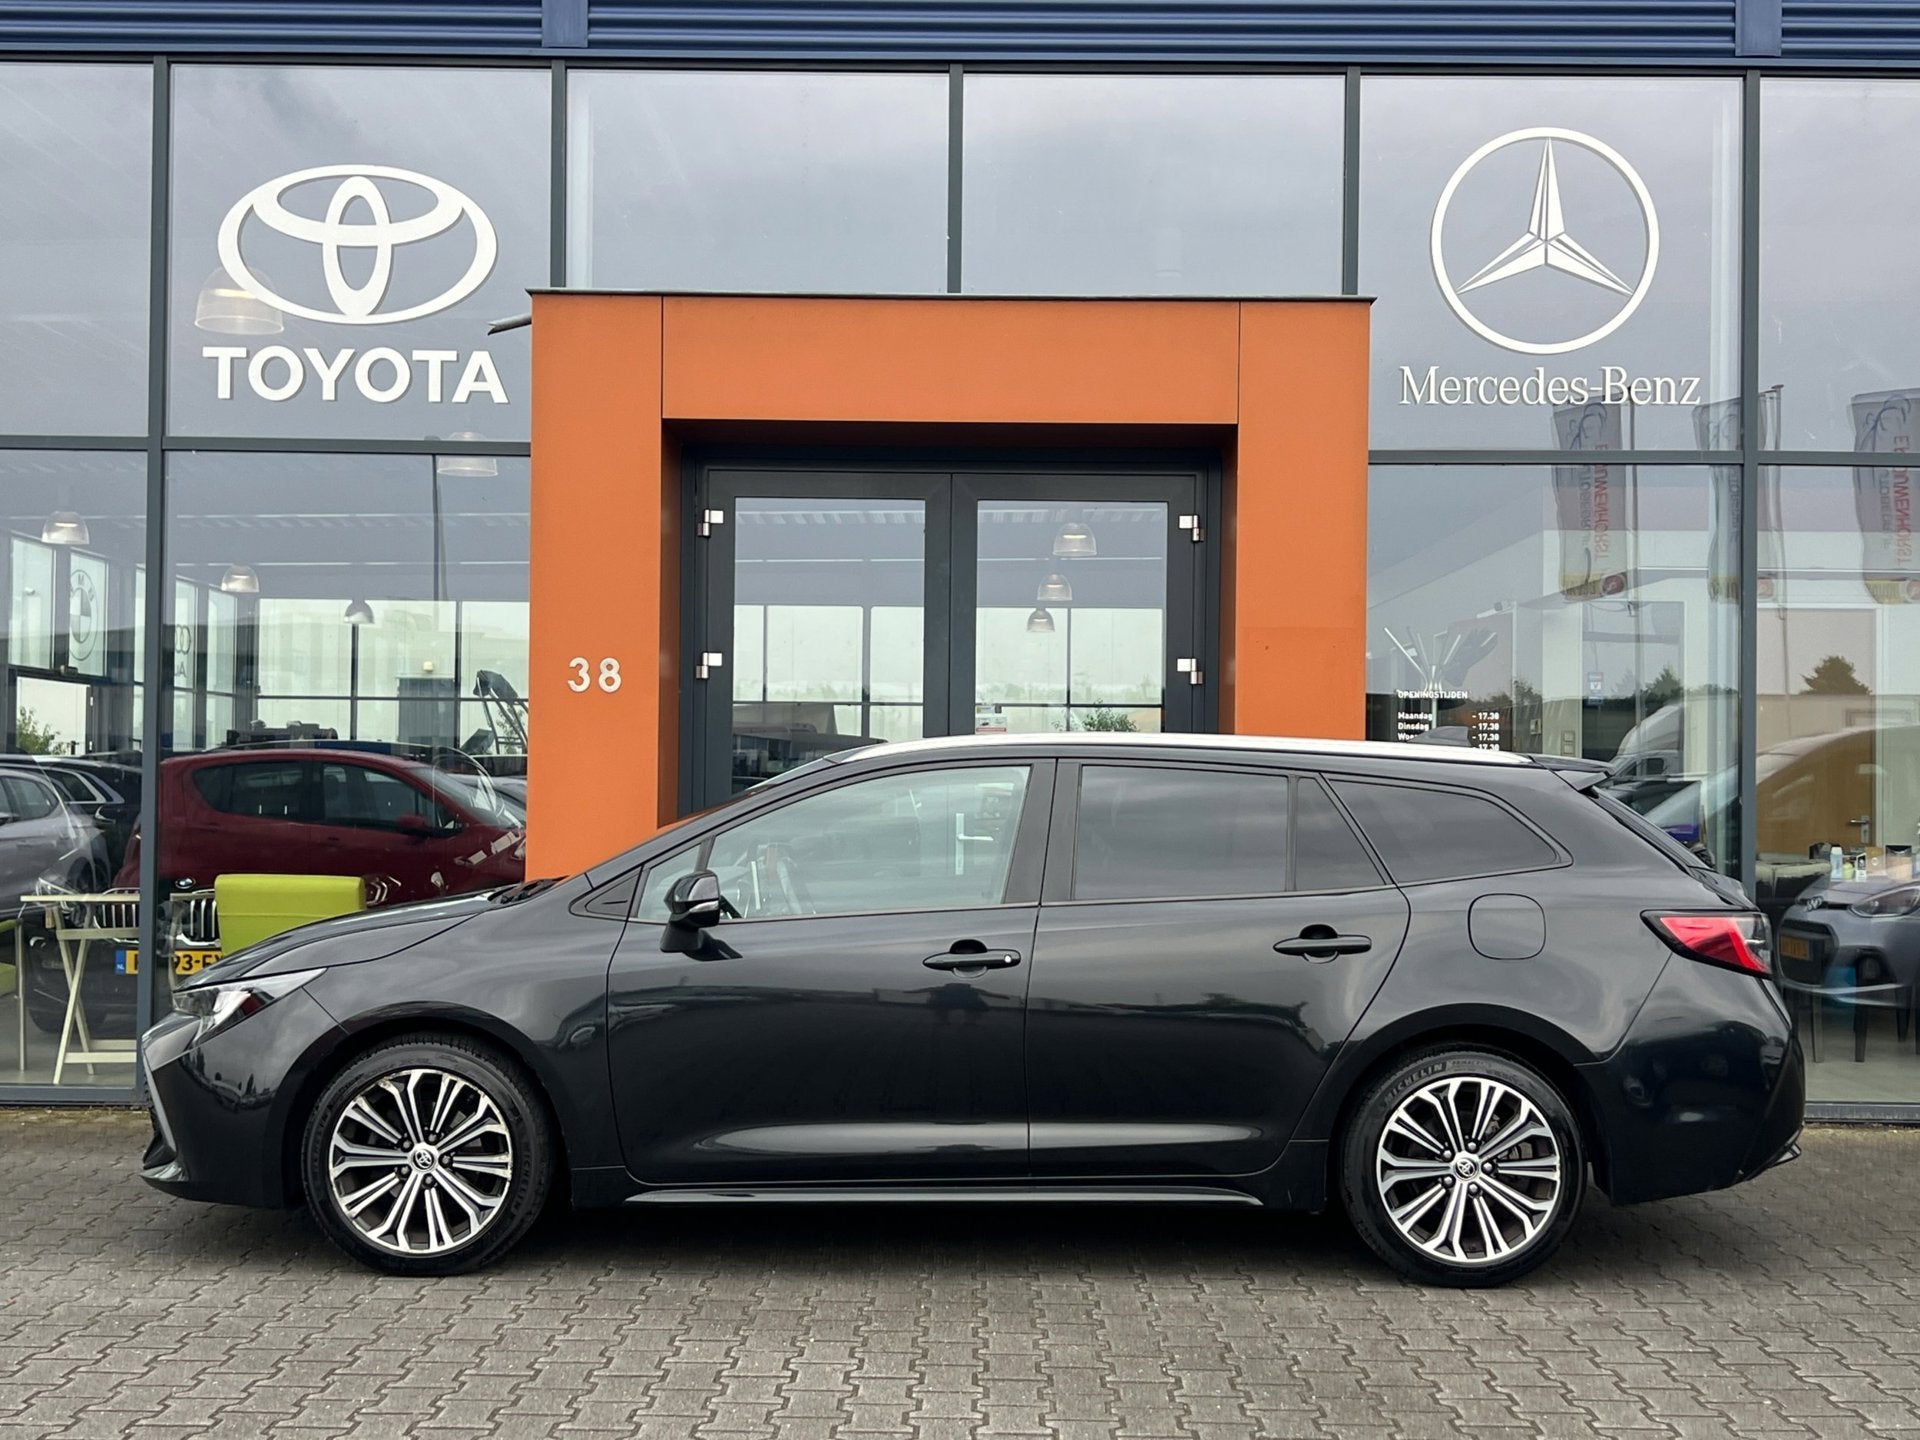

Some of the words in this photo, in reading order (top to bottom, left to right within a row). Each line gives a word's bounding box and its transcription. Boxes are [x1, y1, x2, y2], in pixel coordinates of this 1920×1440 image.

[202, 345, 510, 404] TOYOTA
[1400, 365, 1701, 405] Mercedes-Benz
[567, 656, 622, 693] 38
[1397, 690, 1468, 699] OPENINGSTIJDEN
[1397, 712, 1433, 721] Maandag
[1478, 712, 1500, 720] 17.30
[1397, 722, 1430, 731] Dinsdag
[1478, 722, 1500, 731] 17.30
[1478, 733, 1500, 741] 17.30
[1478, 743, 1500, 751] 1730
[1384, 1061, 1444, 1105] MICHELIN
